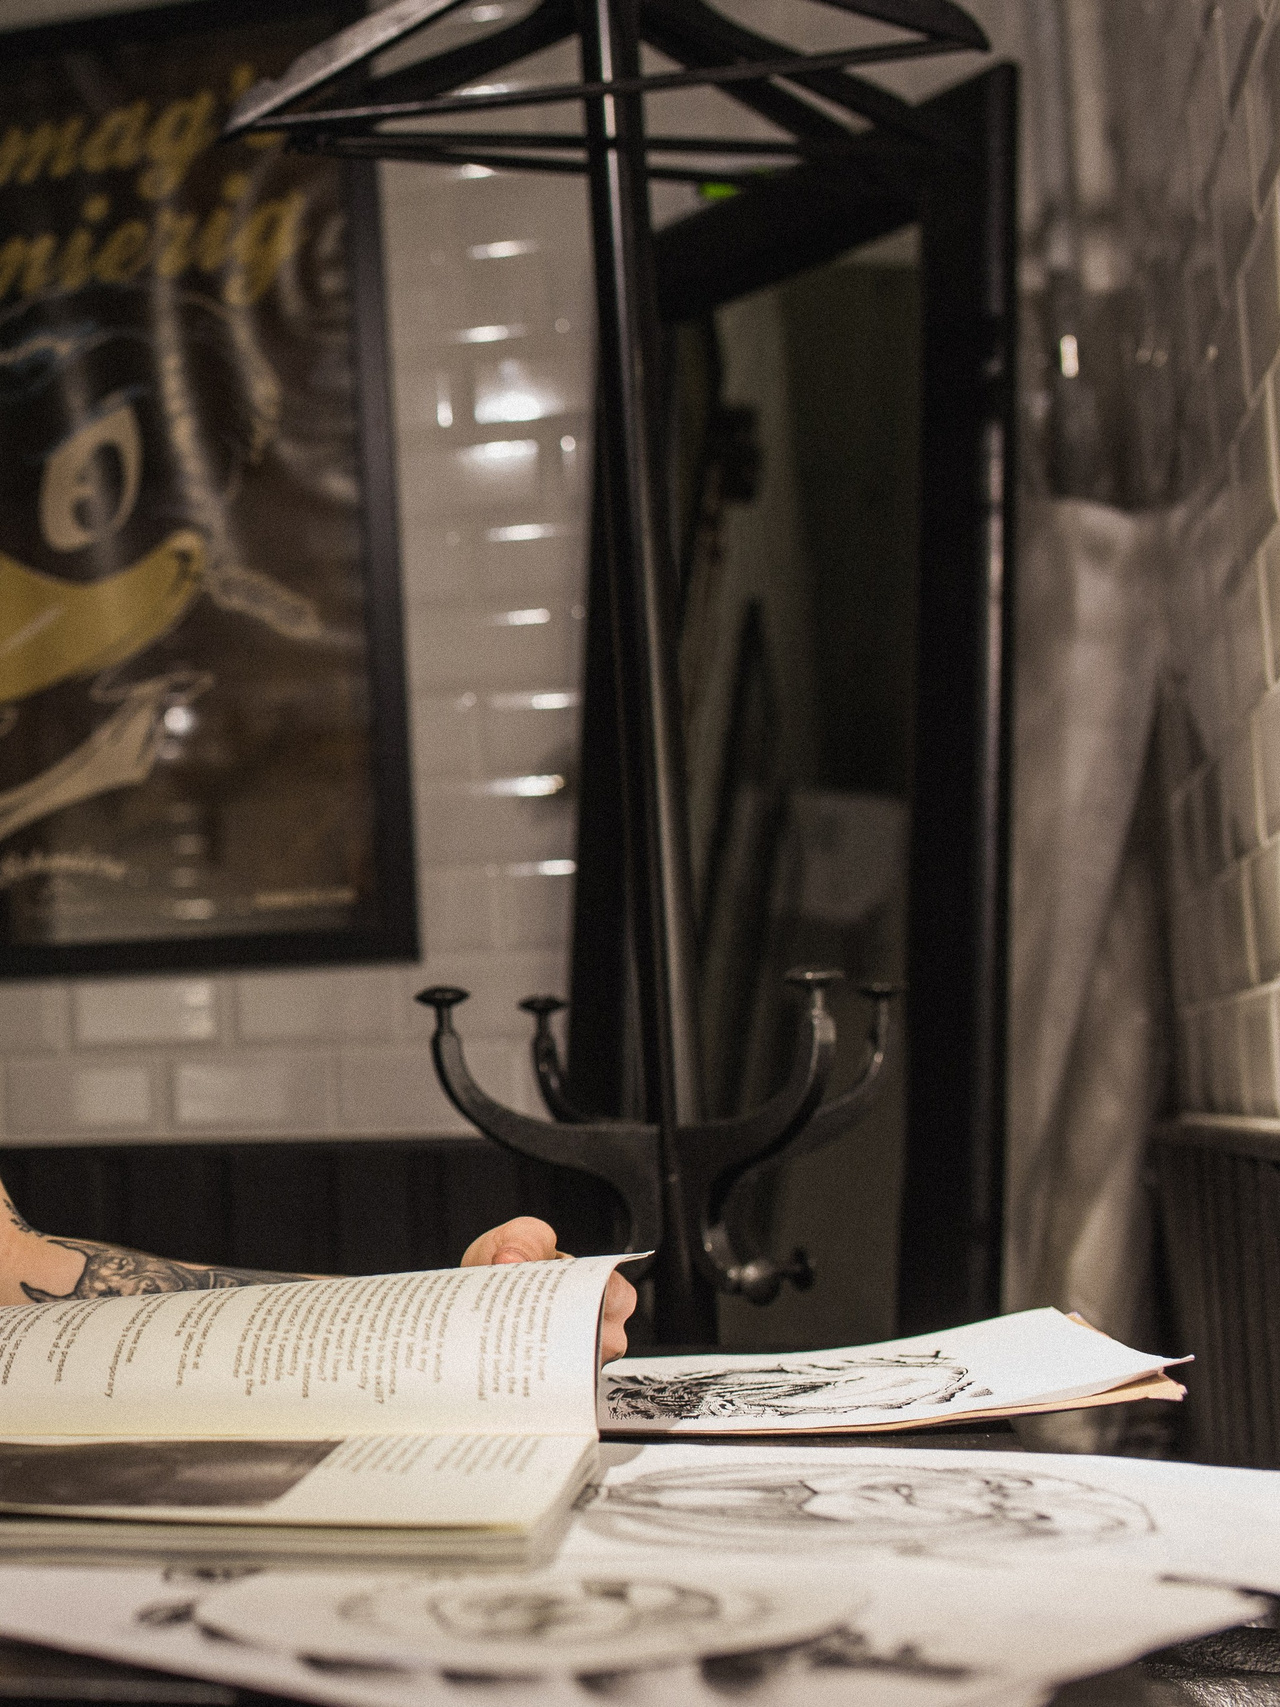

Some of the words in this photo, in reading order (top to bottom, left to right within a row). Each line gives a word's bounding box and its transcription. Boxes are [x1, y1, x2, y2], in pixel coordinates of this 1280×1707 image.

[11, 1339, 24, 1351] can
[194, 1341, 208, 1358] look
[232, 1344, 246, 1379] another
[0, 1351, 17, 1386] propose
[53, 1350, 69, 1385] present.
[103, 1339, 127, 1399] contemporary
[191, 1360, 201, 1371] at
[259, 1347, 273, 1387] practice
[244, 1378, 256, 1397] the
